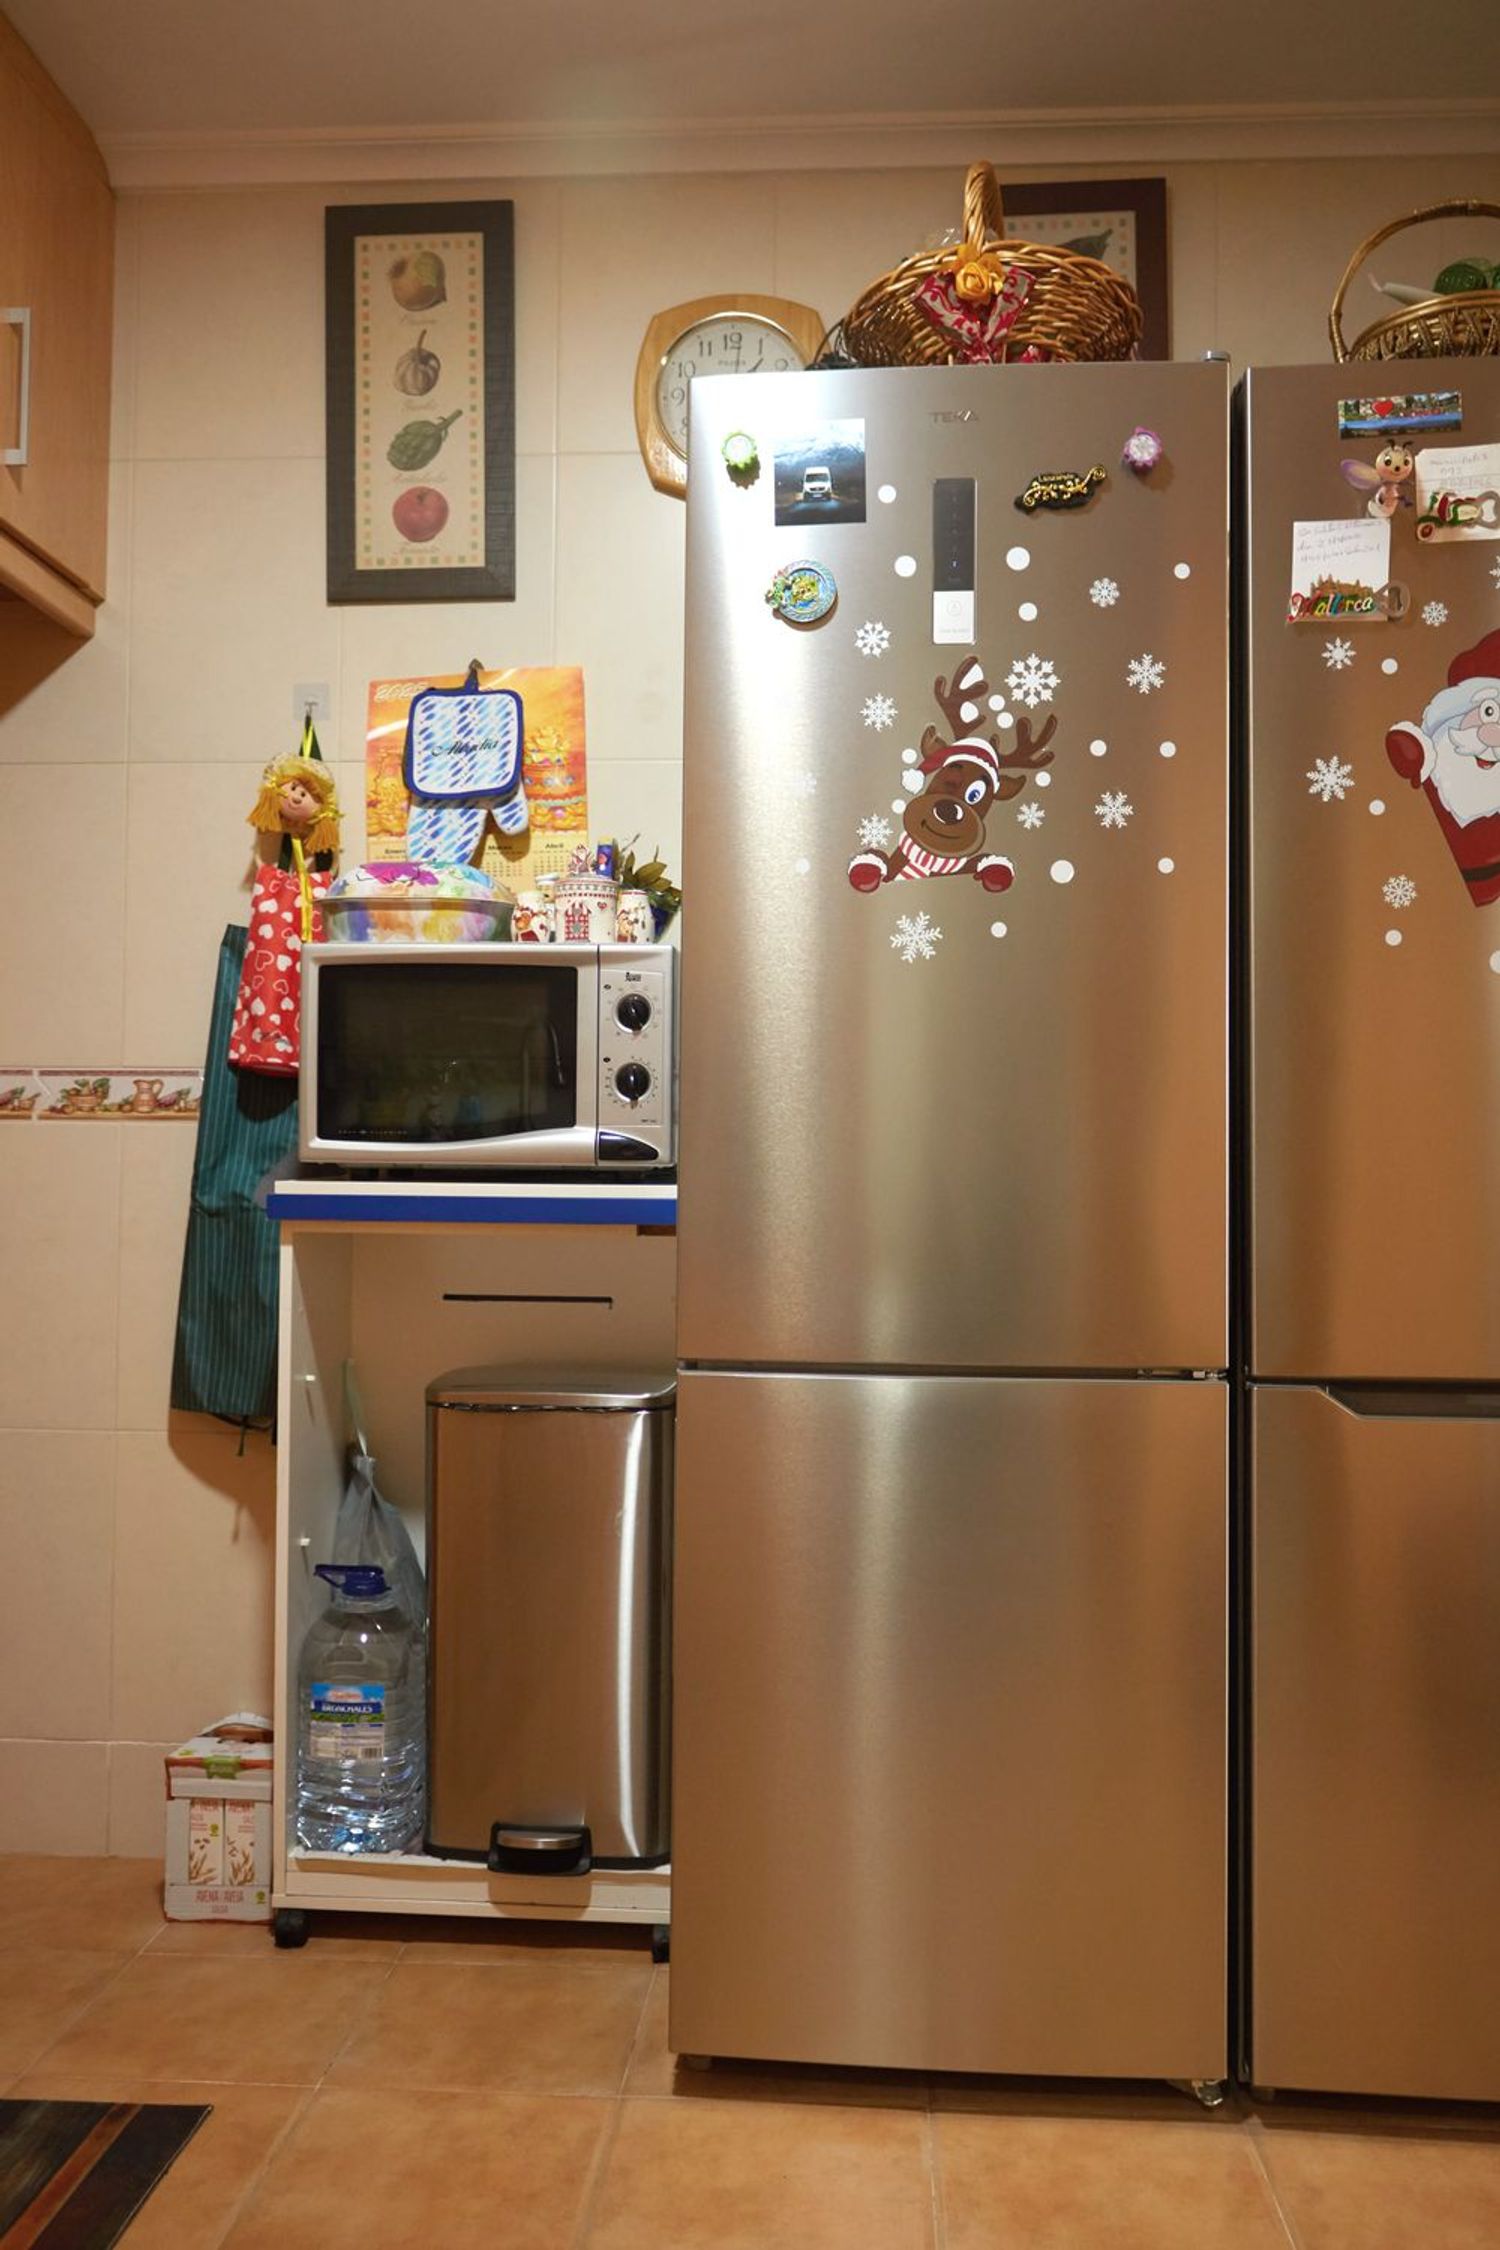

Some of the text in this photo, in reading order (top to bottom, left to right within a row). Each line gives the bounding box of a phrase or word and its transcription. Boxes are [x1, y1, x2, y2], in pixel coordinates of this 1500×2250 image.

[699, 340, 713, 357] 11
[678, 360, 697, 379] 10
[670, 387, 686, 409] 9
[1287, 591, 1374, 622] Mallorca
